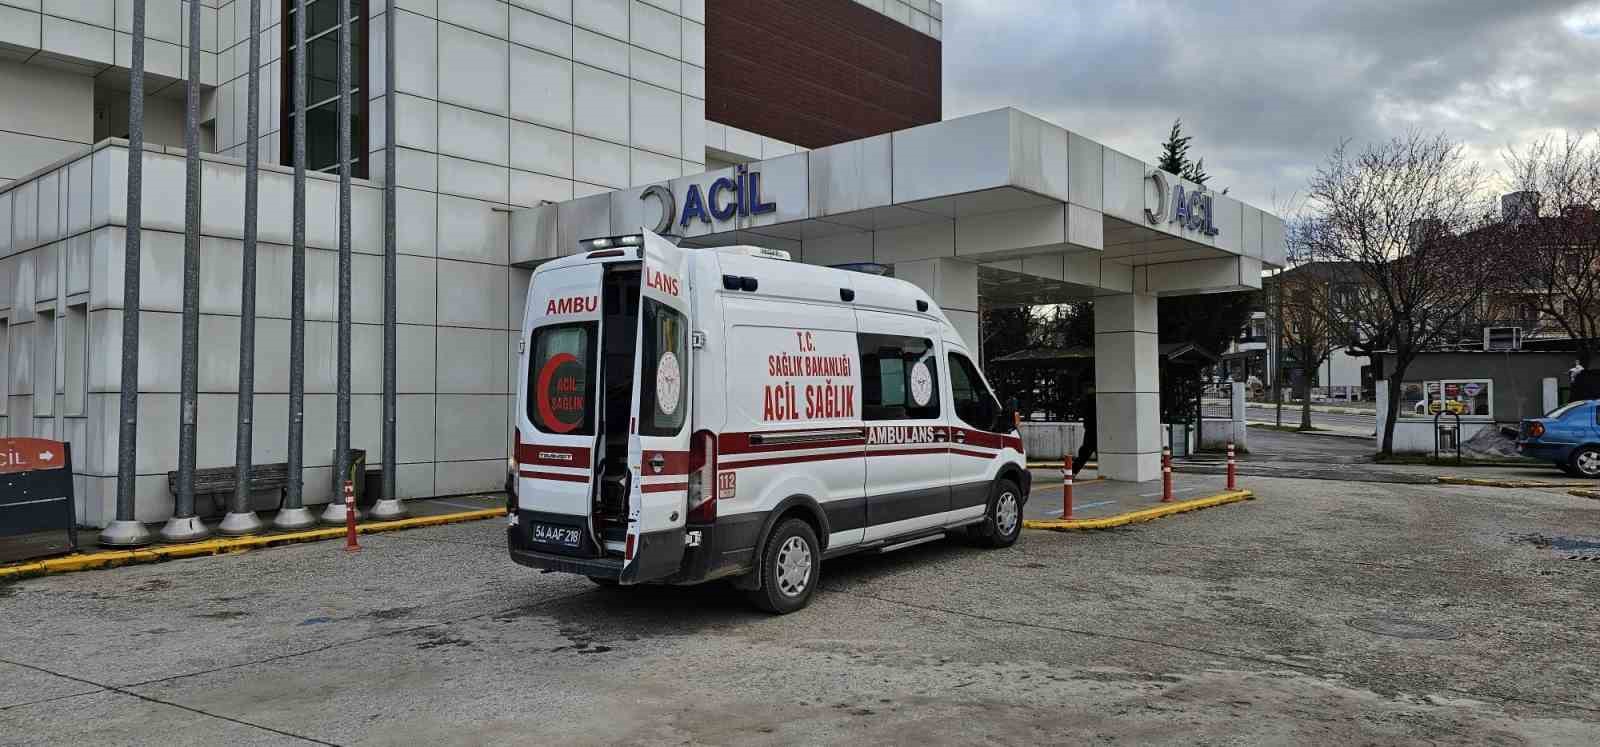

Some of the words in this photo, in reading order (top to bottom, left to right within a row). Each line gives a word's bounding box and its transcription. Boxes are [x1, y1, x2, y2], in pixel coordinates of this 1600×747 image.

[680, 164, 776, 227] ACİL
[646, 266, 679, 296] LANS
[546, 295, 598, 315] AMBU
[797, 331, 816, 352] T.C.
[769, 352, 803, 376] SAĞLIK
[805, 354, 851, 376] BAKANLIĞI
[764, 381, 799, 421] ACİL
[806, 378, 854, 419] SAĞLIK
[868, 427, 934, 444] AMBULANS
[720, 474, 735, 489] 112
[535, 525, 545, 537] 54
